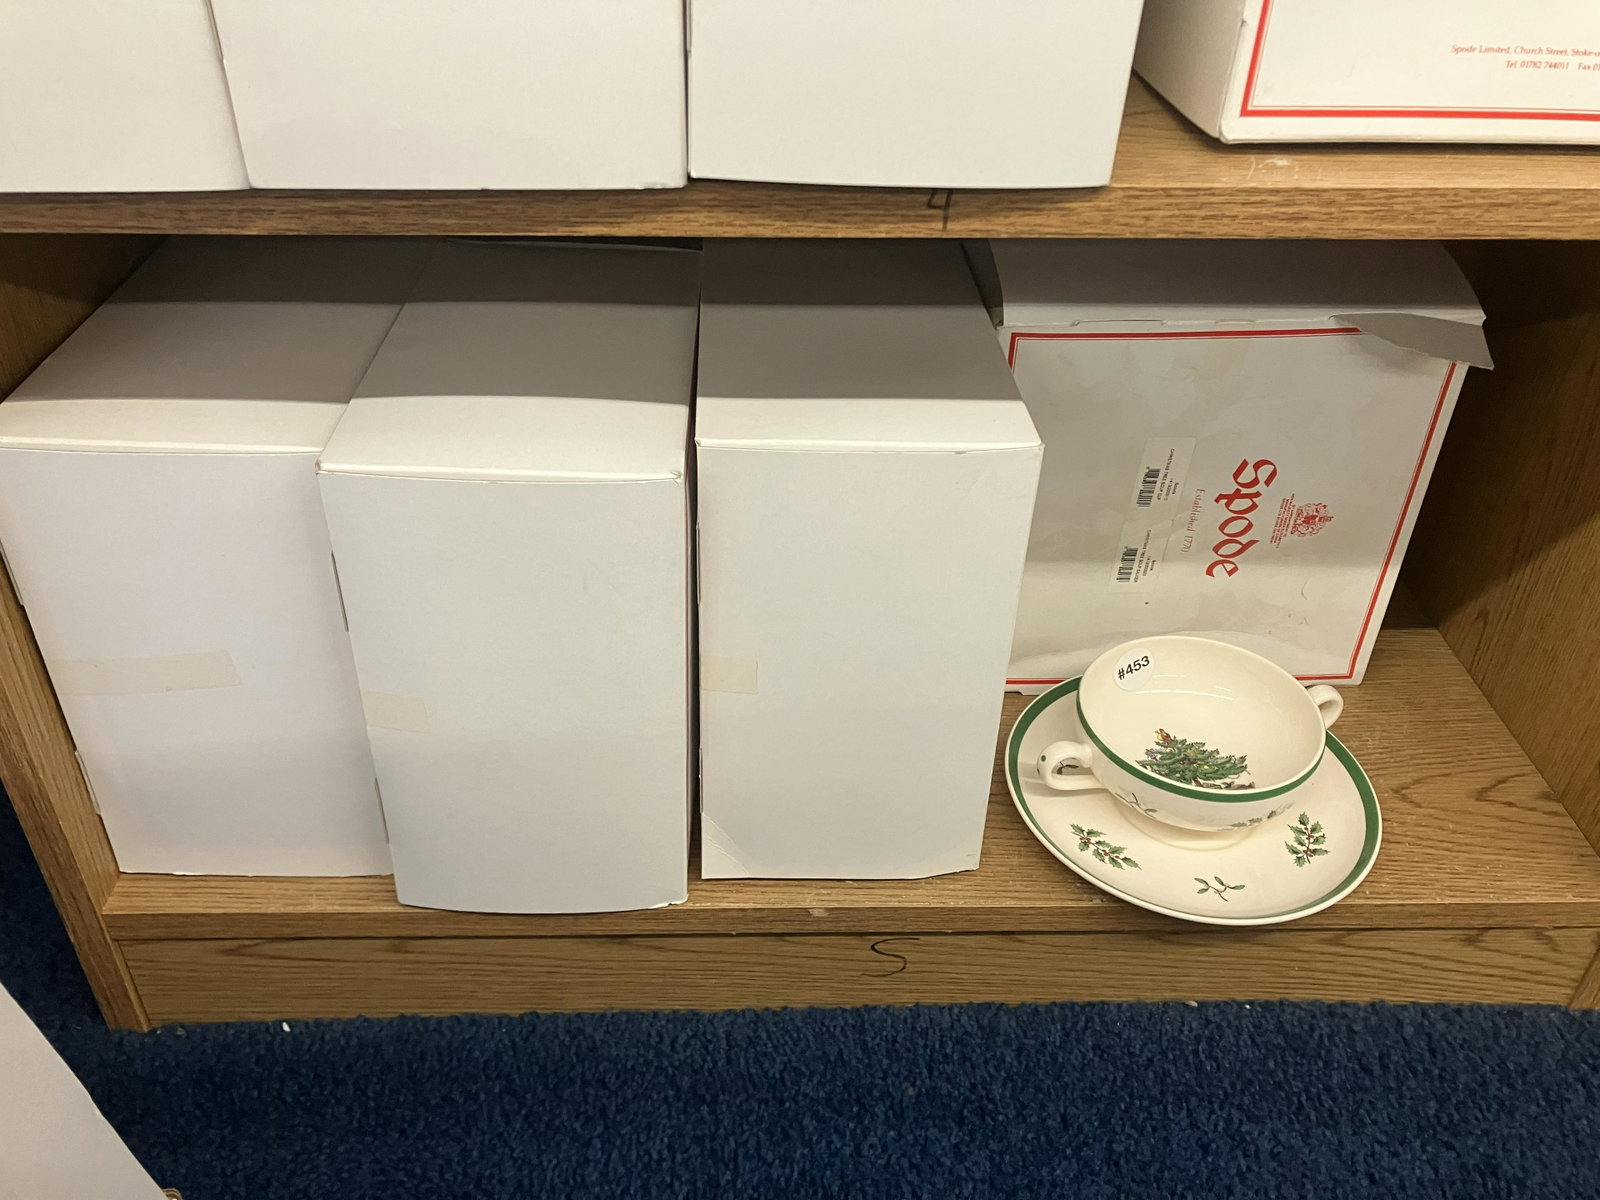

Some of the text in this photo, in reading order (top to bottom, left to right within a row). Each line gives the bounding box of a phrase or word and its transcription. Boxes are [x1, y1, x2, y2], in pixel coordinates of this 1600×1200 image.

[1451, 45, 1477, 55] Spode
[1514, 46, 1543, 56] Church
[1181, 488, 1206, 553] Established 1770
[1205, 458, 1278, 578] Spode
[1117, 655, 1150, 681] #453
